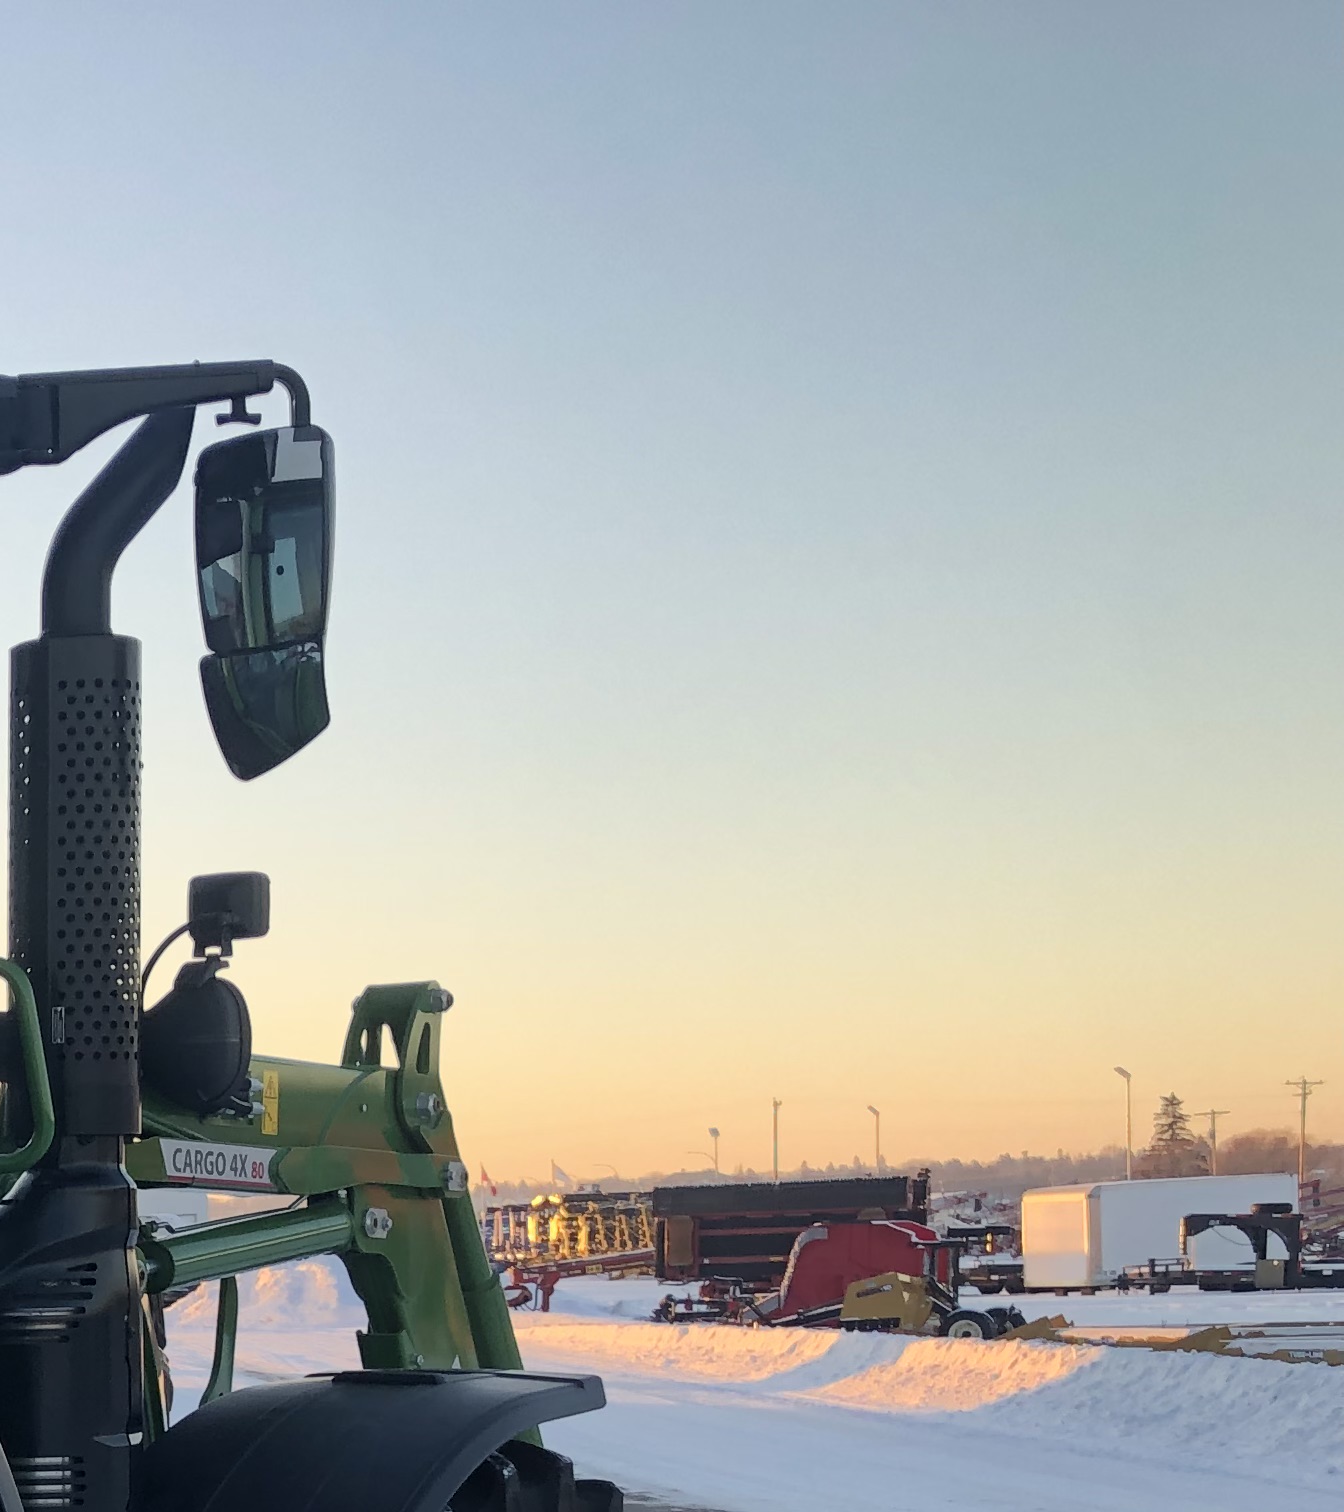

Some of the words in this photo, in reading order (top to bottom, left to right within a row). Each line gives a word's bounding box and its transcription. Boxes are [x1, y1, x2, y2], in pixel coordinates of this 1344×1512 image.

[172, 1148, 226, 1176] CARGO
[230, 1154, 248, 1178] 4X
[251, 1161, 264, 1179] 80
